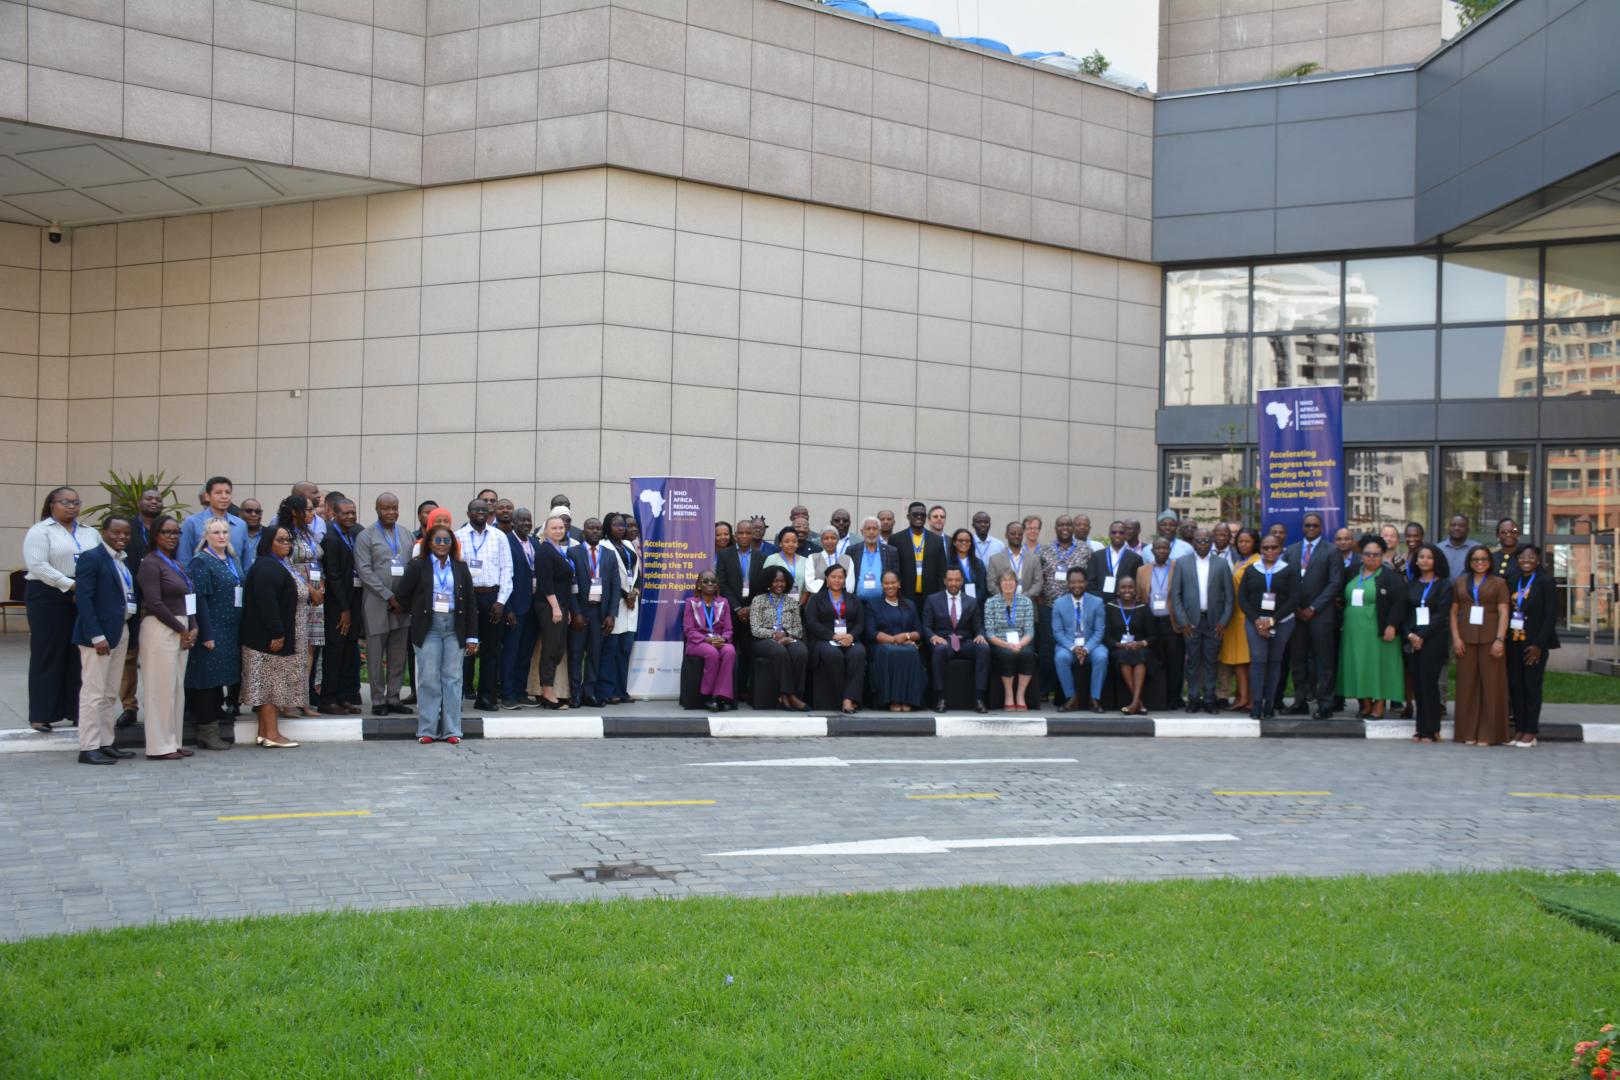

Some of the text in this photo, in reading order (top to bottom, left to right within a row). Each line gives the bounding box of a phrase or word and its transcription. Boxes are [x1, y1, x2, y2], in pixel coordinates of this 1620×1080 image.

[1270, 450, 1317, 459] Accelerating
[1270, 459, 1336, 470] progress towards
[1271, 471, 1297, 479] ending
[1311, 469, 1322, 477] TB
[1271, 481, 1305, 489] epidemic
[1271, 490, 1327, 499] African Region
[644, 540, 688, 549] Accelerating
[644, 552, 674, 560] progress
[644, 562, 667, 570] ending
[644, 572, 675, 580] epidemic
[644, 582, 696, 591] African Region
